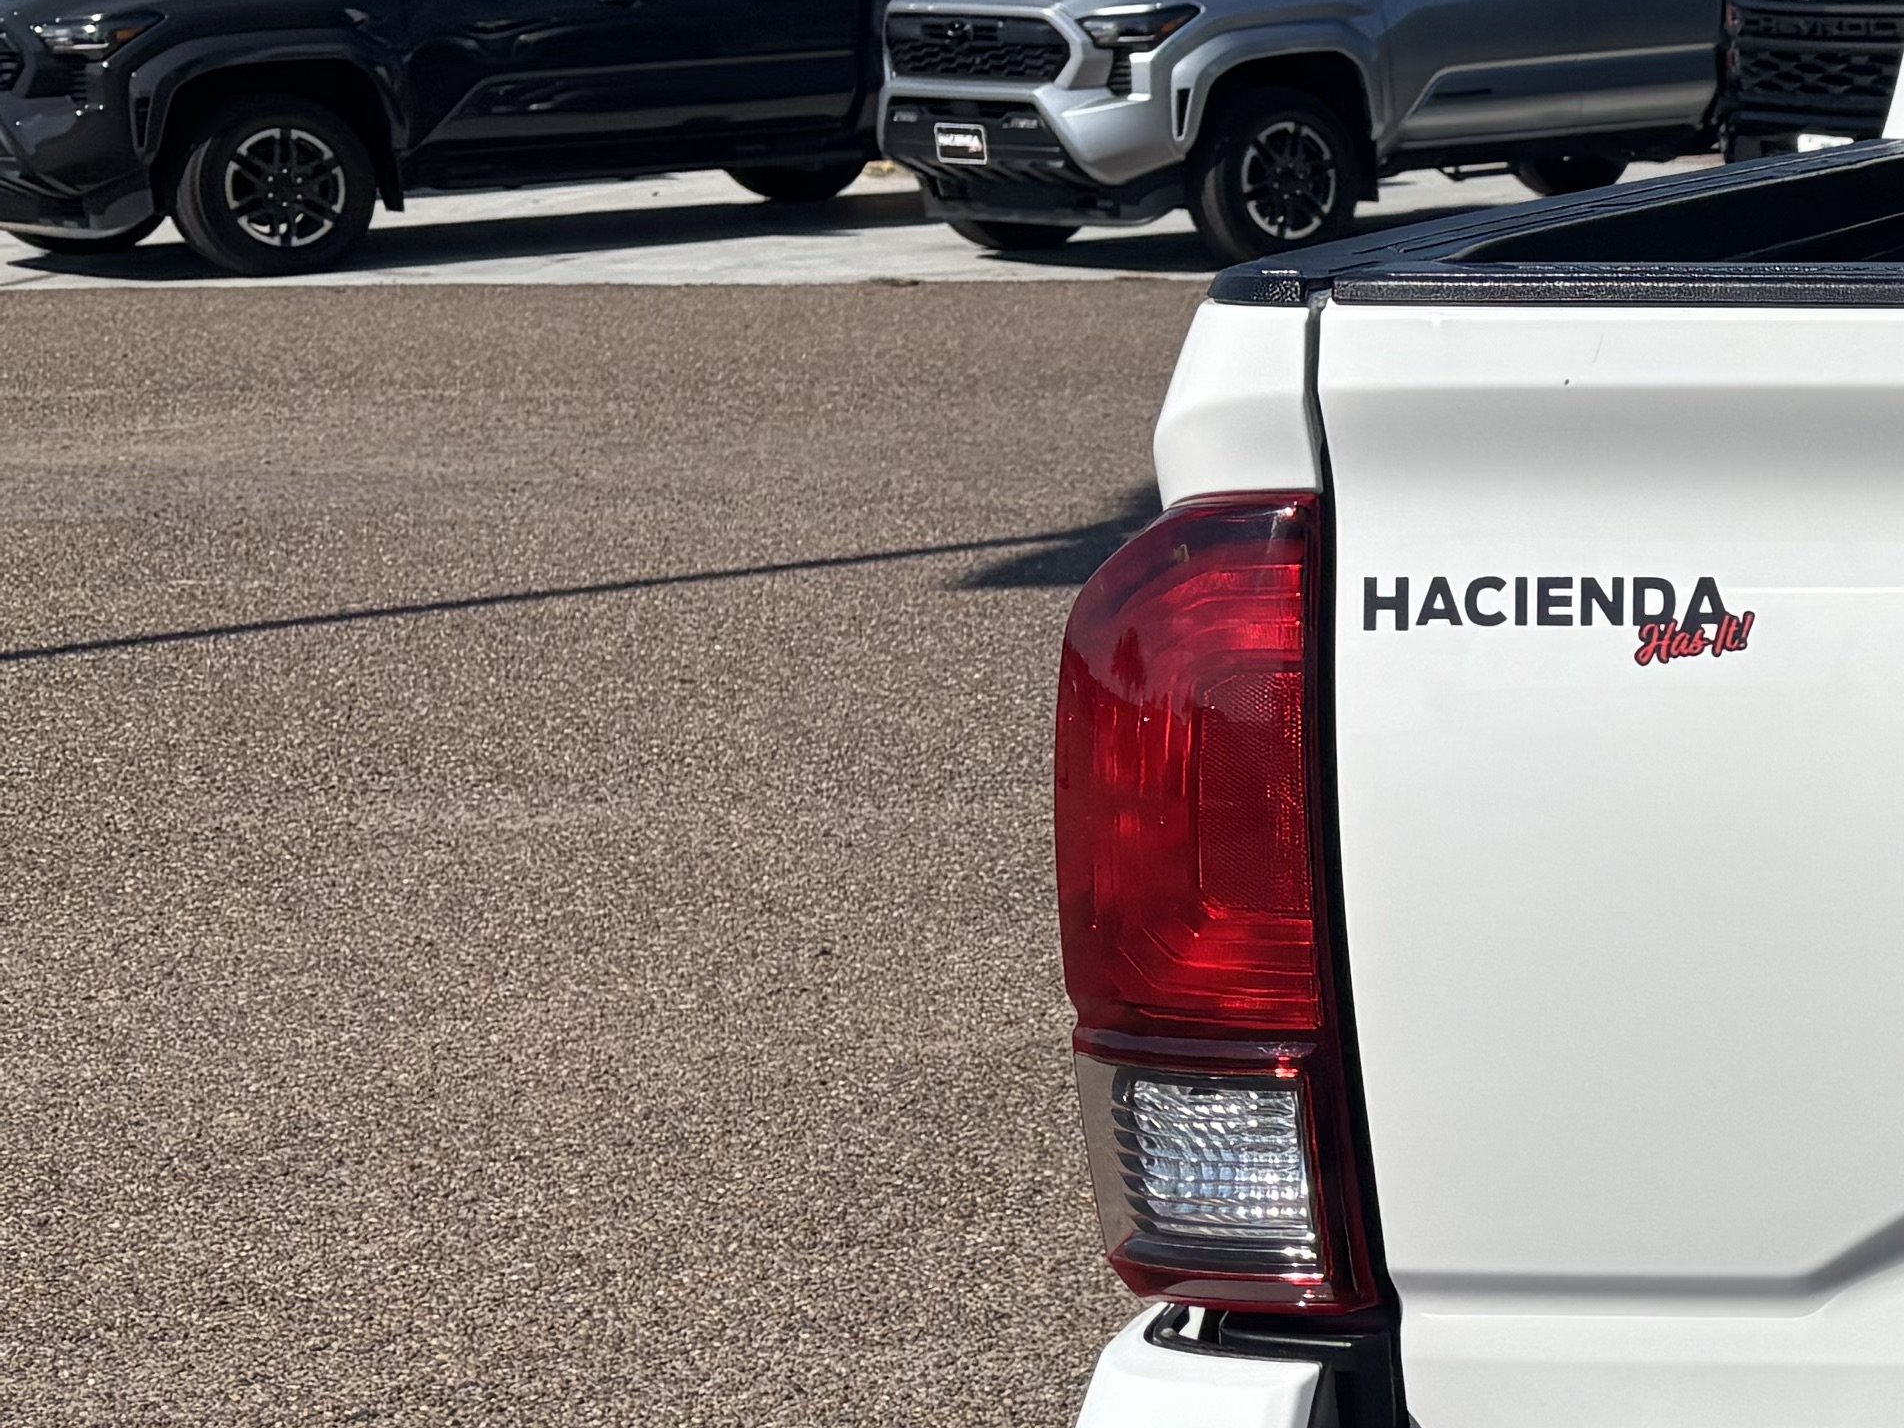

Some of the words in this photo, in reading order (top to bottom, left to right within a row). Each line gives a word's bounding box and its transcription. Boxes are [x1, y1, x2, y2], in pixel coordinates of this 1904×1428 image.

[1363, 576, 1728, 631] HACIENDA
[1634, 618, 1708, 666] Has
[1712, 610, 1756, 657] It!
